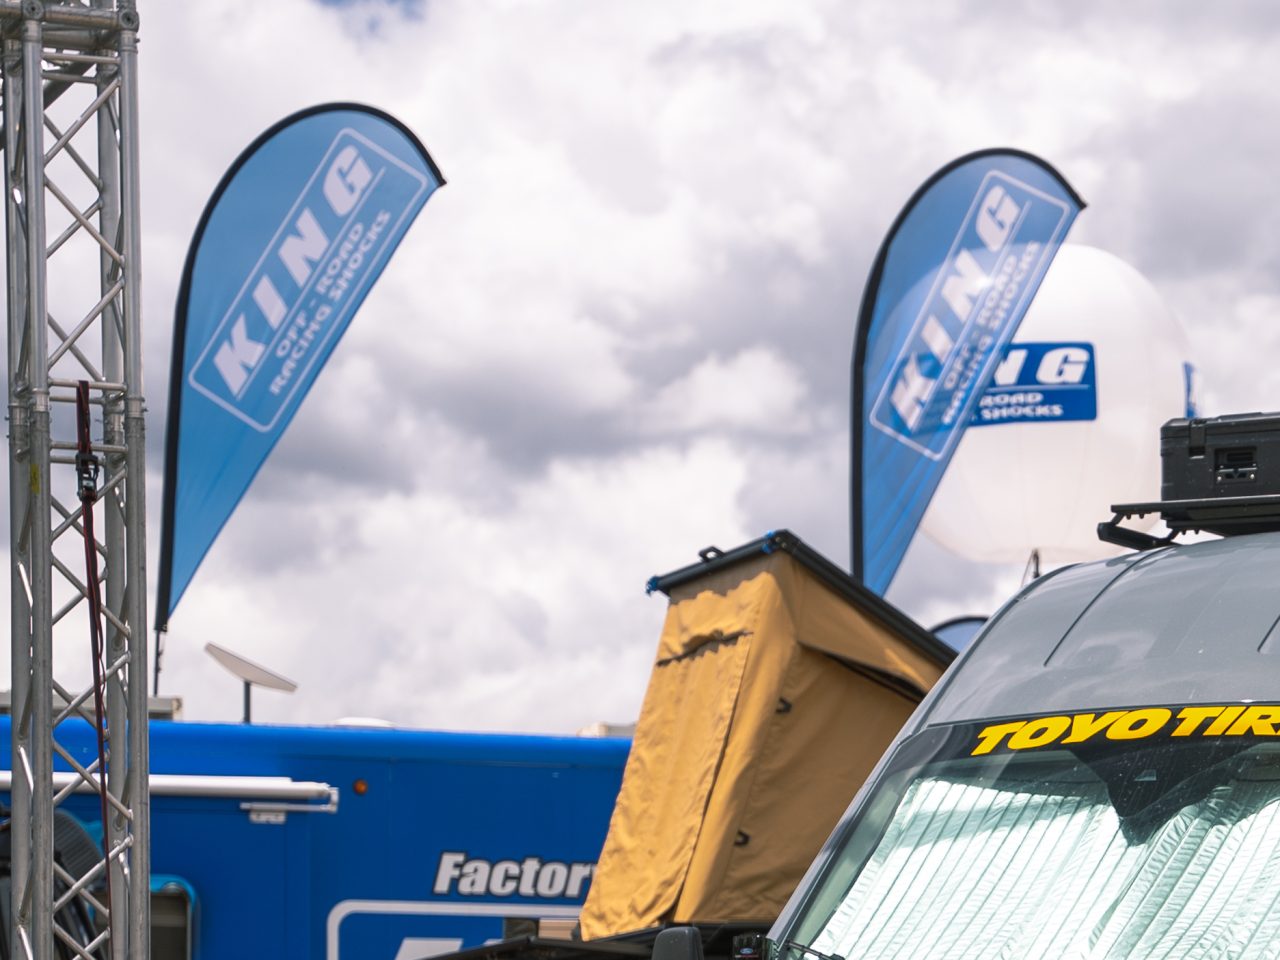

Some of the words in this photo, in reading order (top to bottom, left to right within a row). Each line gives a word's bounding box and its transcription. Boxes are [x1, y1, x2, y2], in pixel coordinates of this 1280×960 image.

[213, 145, 373, 397] KING
[268, 304, 333, 396] RACING
[328, 209, 392, 303] SHOCKS
[276, 310, 307, 358] OFF
[316, 222, 364, 296] ROAD
[890, 185, 1021, 431] KING
[943, 344, 971, 391] OFF
[976, 255, 1018, 326] ROAD
[989, 240, 1041, 330] SHOCKS
[981, 404, 1064, 420] SHOCKS
[970, 708, 1173, 756] TOYO
[433, 852, 597, 897] Factor
